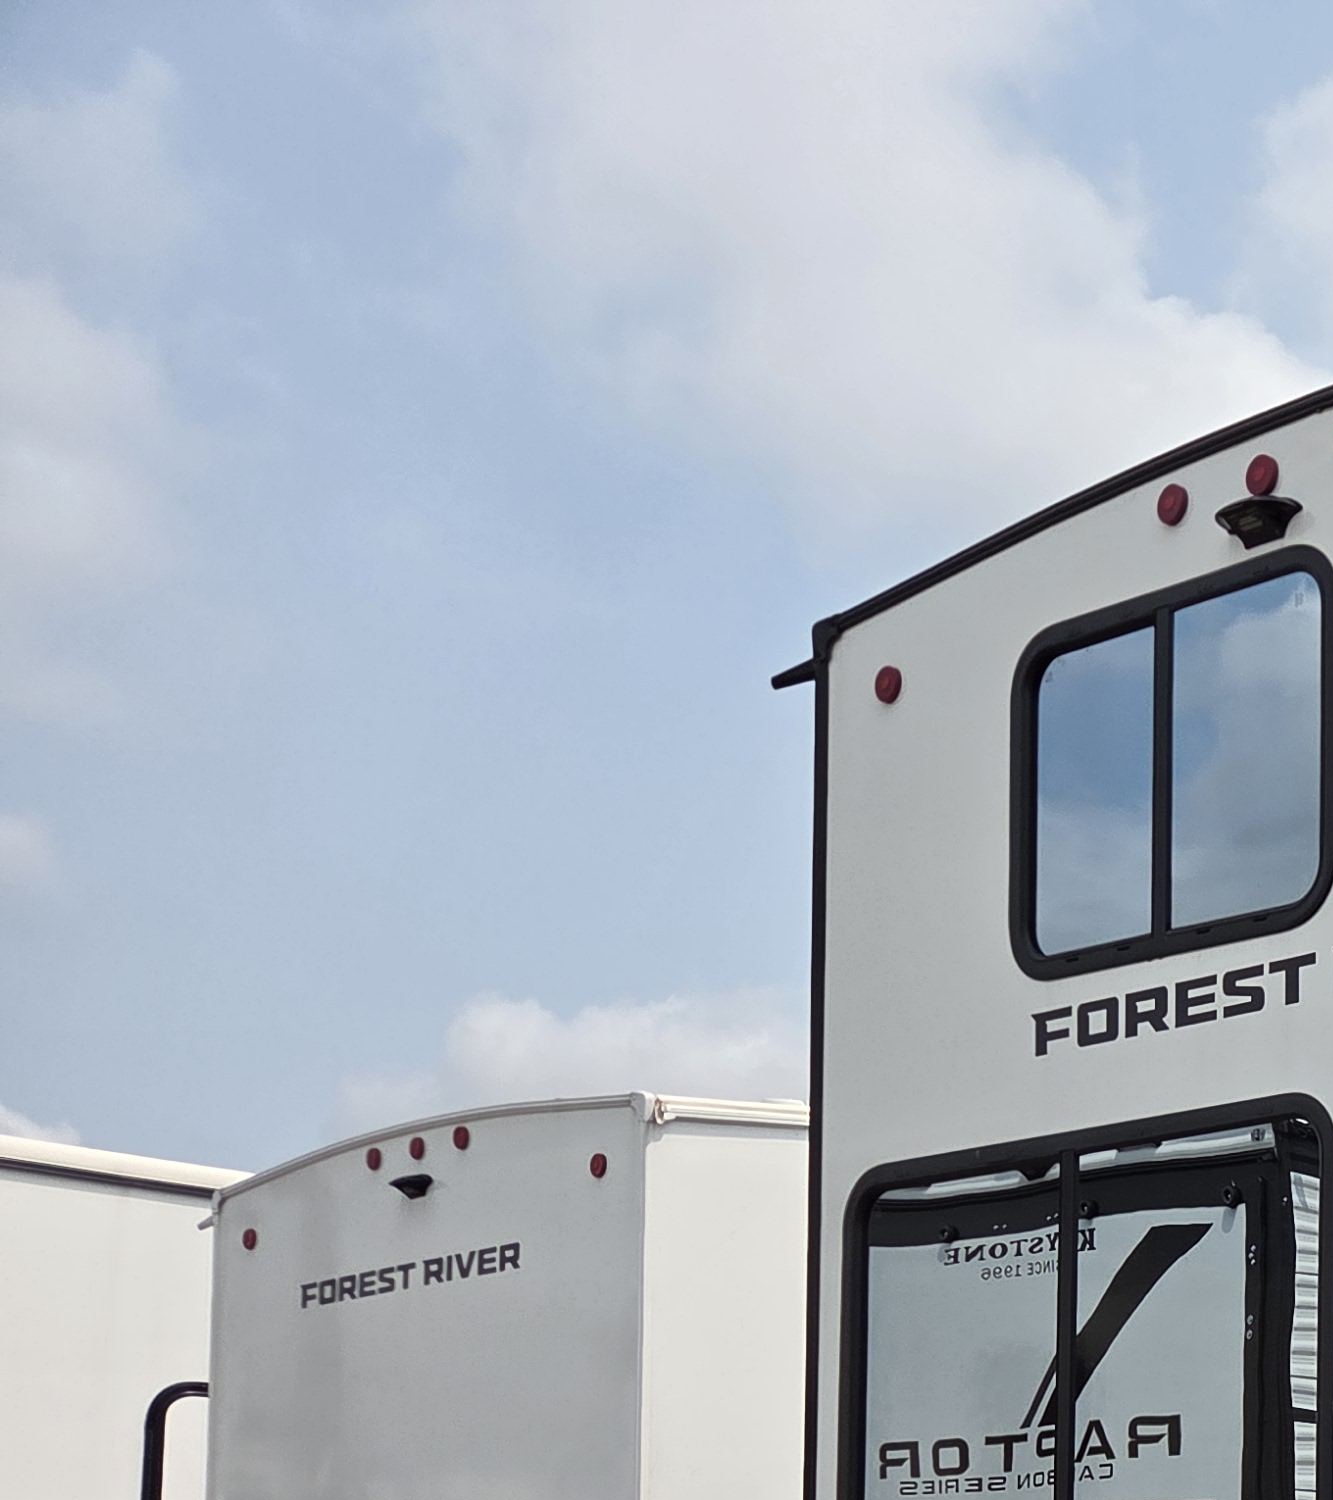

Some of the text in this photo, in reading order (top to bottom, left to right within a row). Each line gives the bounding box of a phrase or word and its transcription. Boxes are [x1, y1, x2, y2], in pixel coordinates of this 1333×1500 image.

[1031, 952, 1317, 1058] FOREST
[301, 1242, 520, 1309] FOREST RIVER
